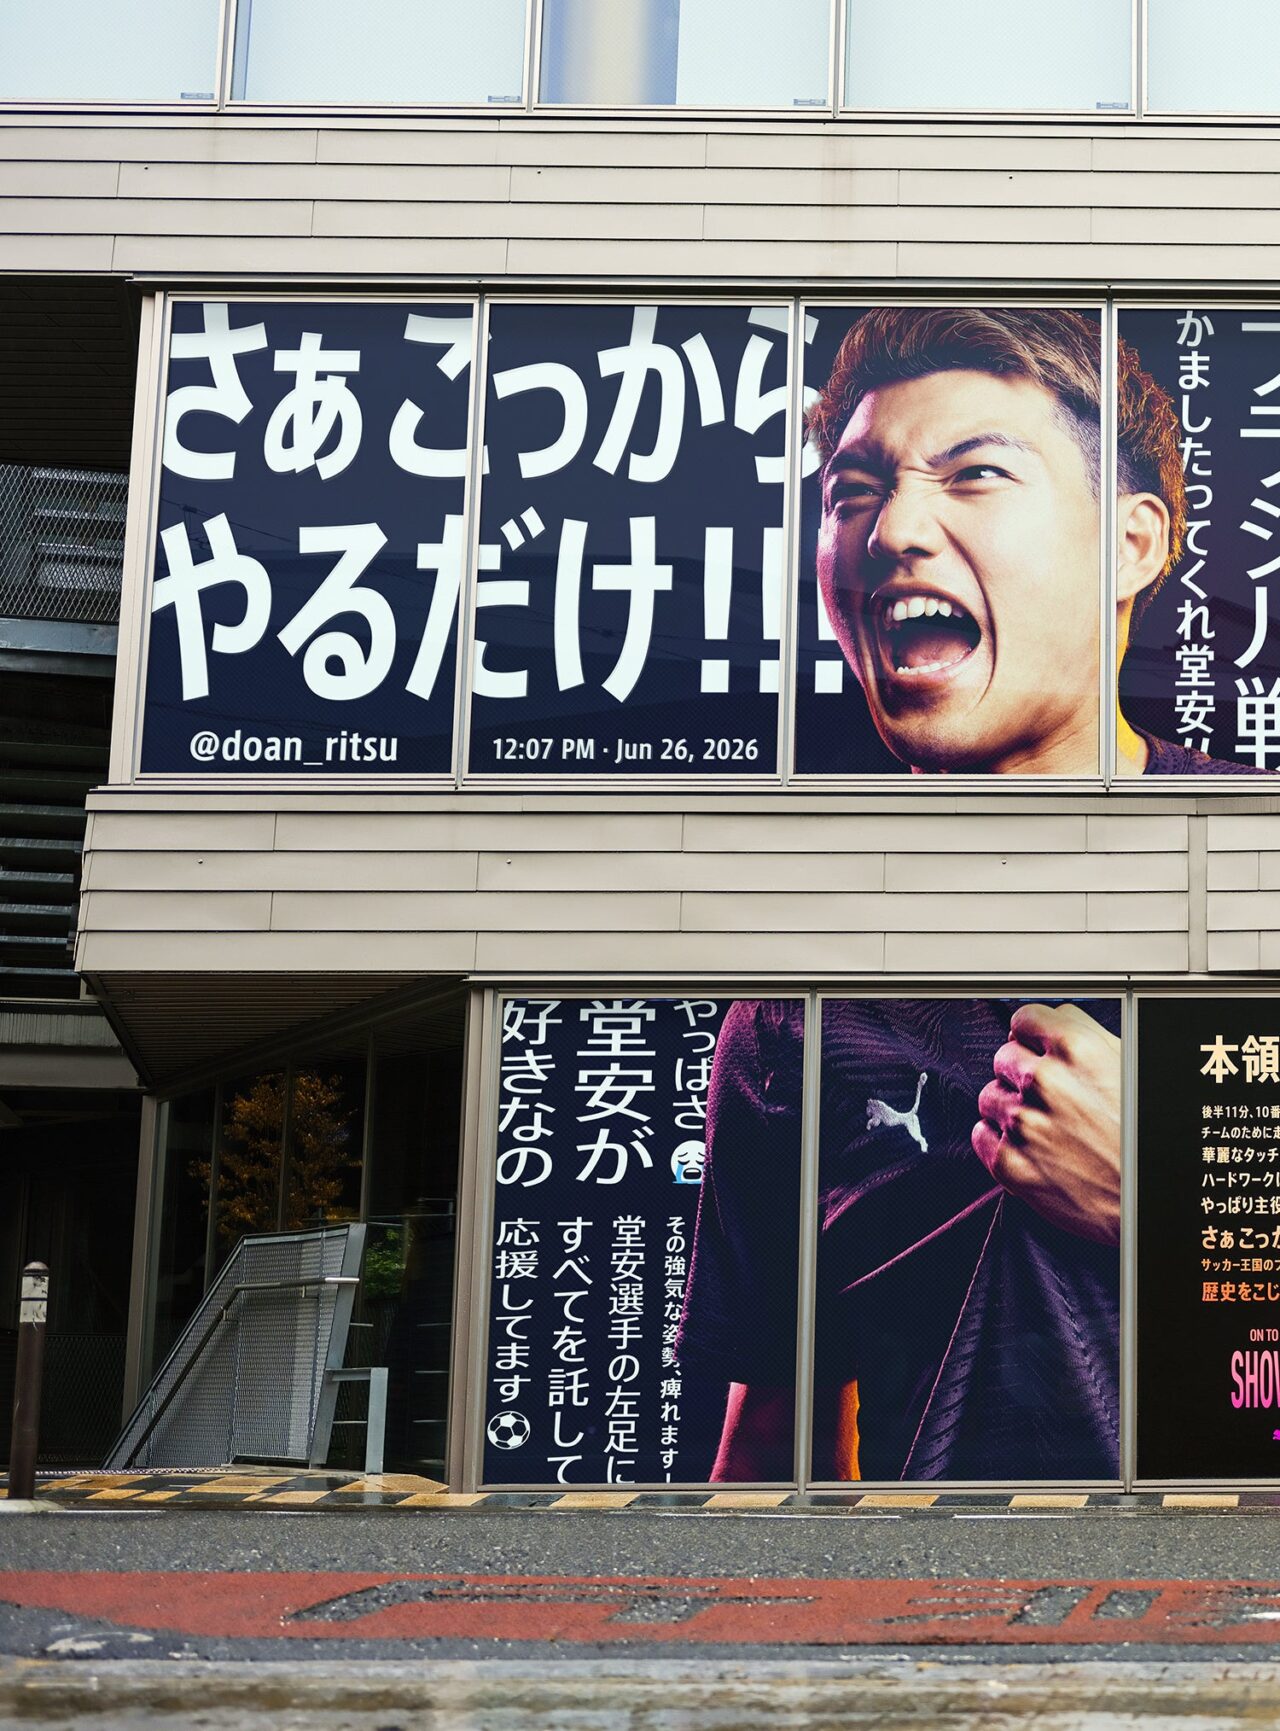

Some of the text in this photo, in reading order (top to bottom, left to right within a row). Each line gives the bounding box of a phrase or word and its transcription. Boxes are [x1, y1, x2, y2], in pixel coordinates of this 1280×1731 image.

[189, 729, 398, 766] @doan_ritsu
[493, 738, 554, 760] 12:07
[561, 738, 595, 760] PM
[614, 738, 652, 764] Jun
[660, 738, 694, 763] 26,
[702, 738, 759, 761] 2026
[495, 999, 563, 1188] 好きなの
[574, 1000, 656, 1185] 堂安が
[672, 1000, 719, 1130] やっぱさ
[493, 1217, 541, 1403] 応援してます
[547, 1216, 594, 1485] すべてを託して
[603, 1214, 646, 1485] 堂安選手の左足に
[1249, 1328, 1264, 1342] ON
[1265, 1328, 1279, 1342] TO
